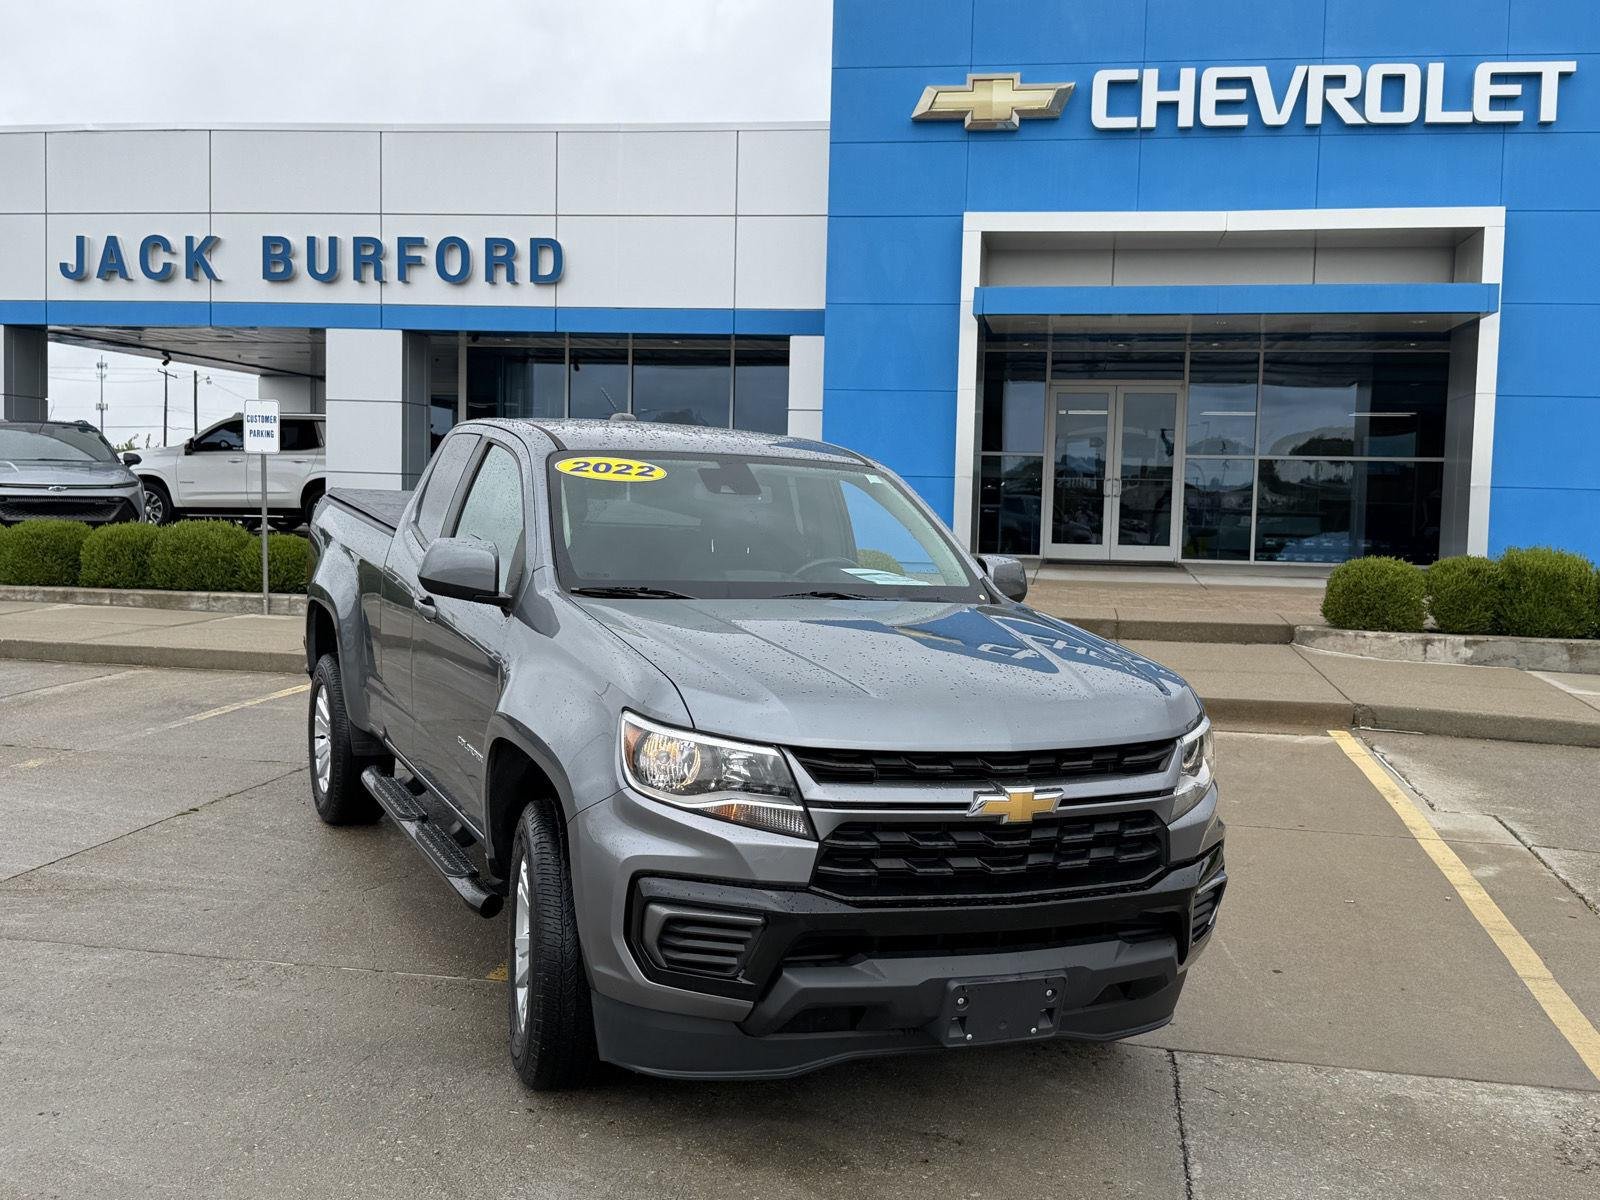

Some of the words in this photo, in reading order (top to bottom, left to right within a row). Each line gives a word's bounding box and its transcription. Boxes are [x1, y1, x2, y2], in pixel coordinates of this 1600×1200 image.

[1091, 61, 1577, 129] CHEVROLET
[59, 234, 223, 283] JACK
[262, 235, 566, 286] BURFORD
[246, 414, 277, 423] CUSTOMER
[249, 429, 275, 438] PARKING
[569, 461, 655, 477] 2022
